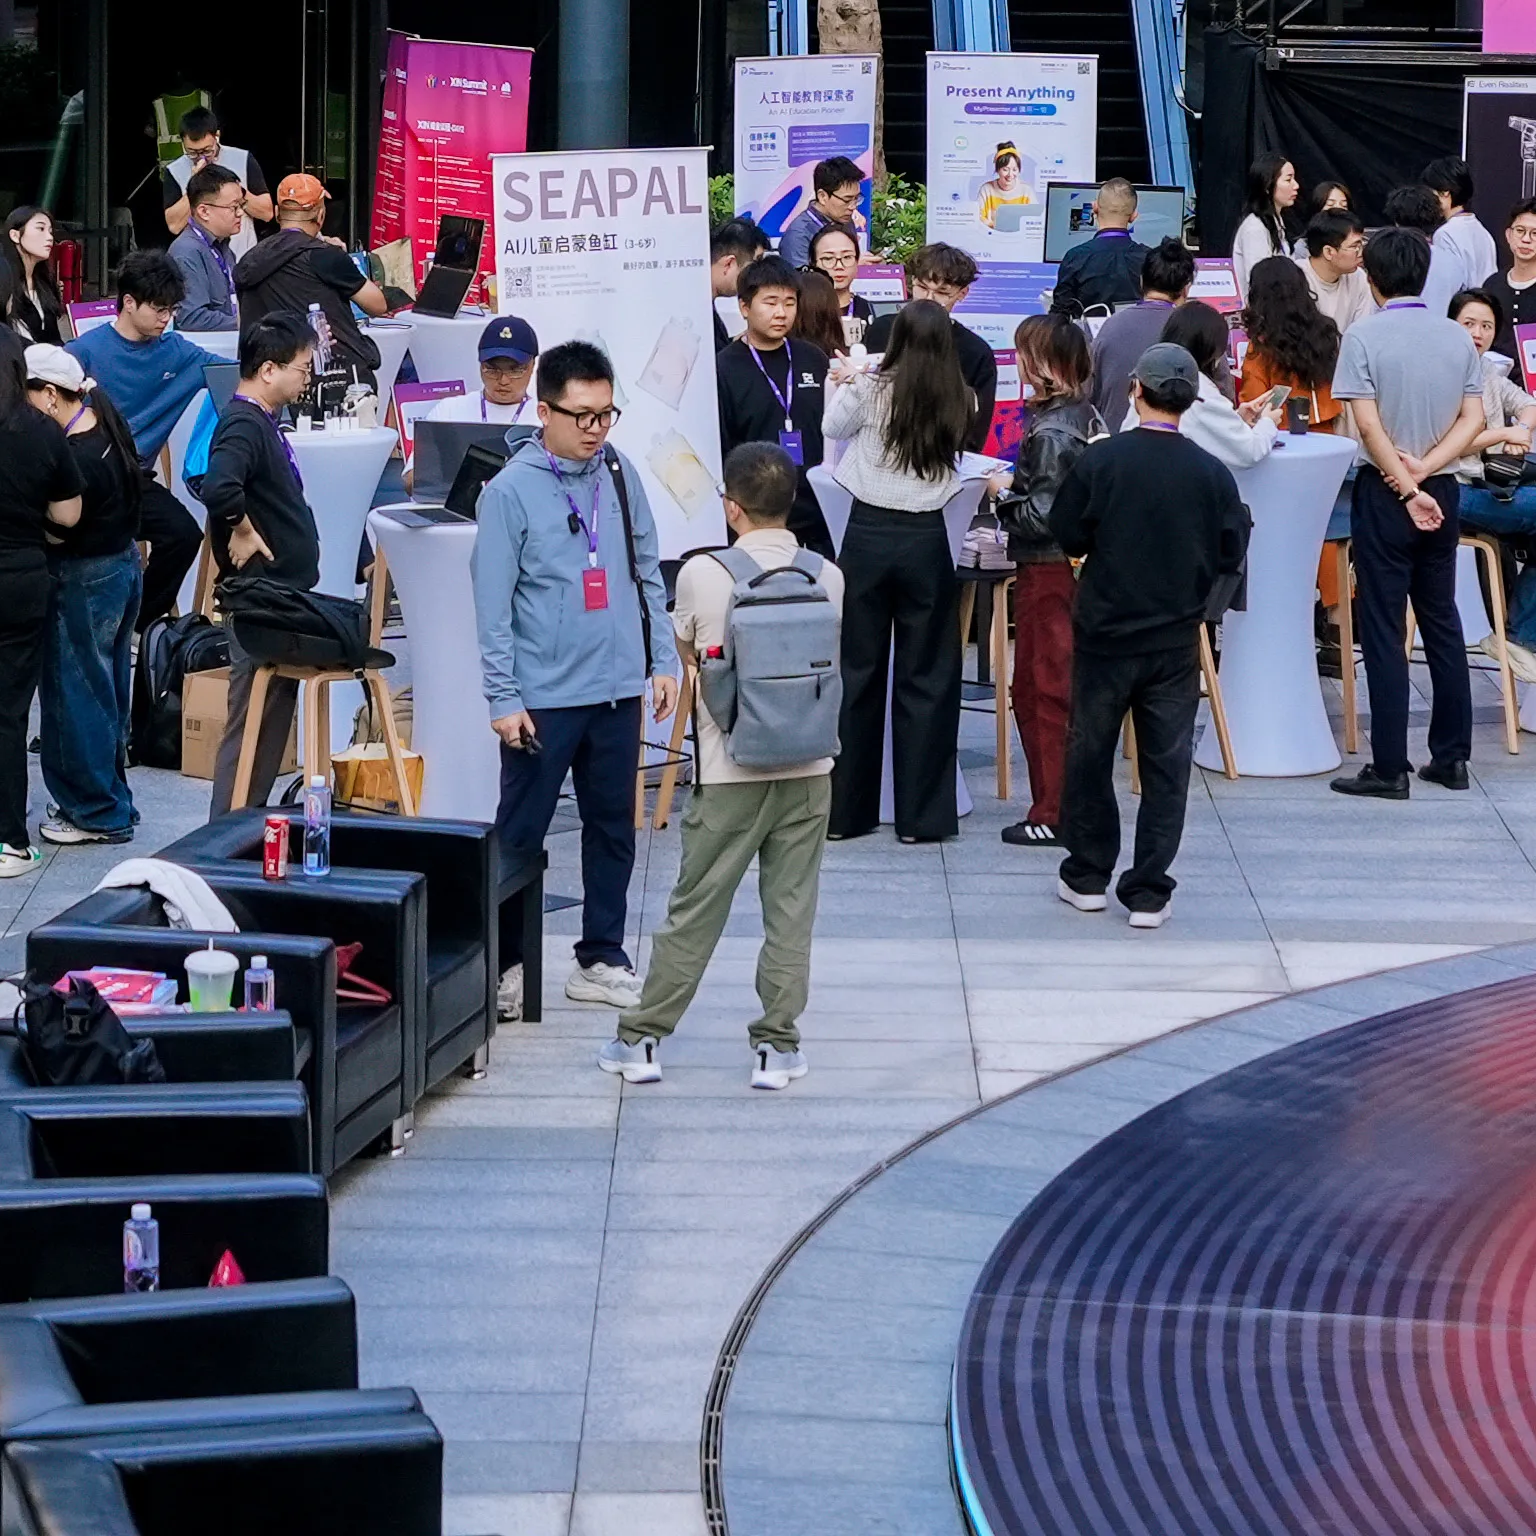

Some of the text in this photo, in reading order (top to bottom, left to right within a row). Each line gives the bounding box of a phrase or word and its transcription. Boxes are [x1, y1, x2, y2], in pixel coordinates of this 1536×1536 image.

[759, 89, 855, 105] 人工智能教育探索者
[946, 85, 1076, 102] Present Anything
[503, 165, 703, 222] SEAPAL
[504, 233, 618, 256] AI儿童启蒙鱼缸
